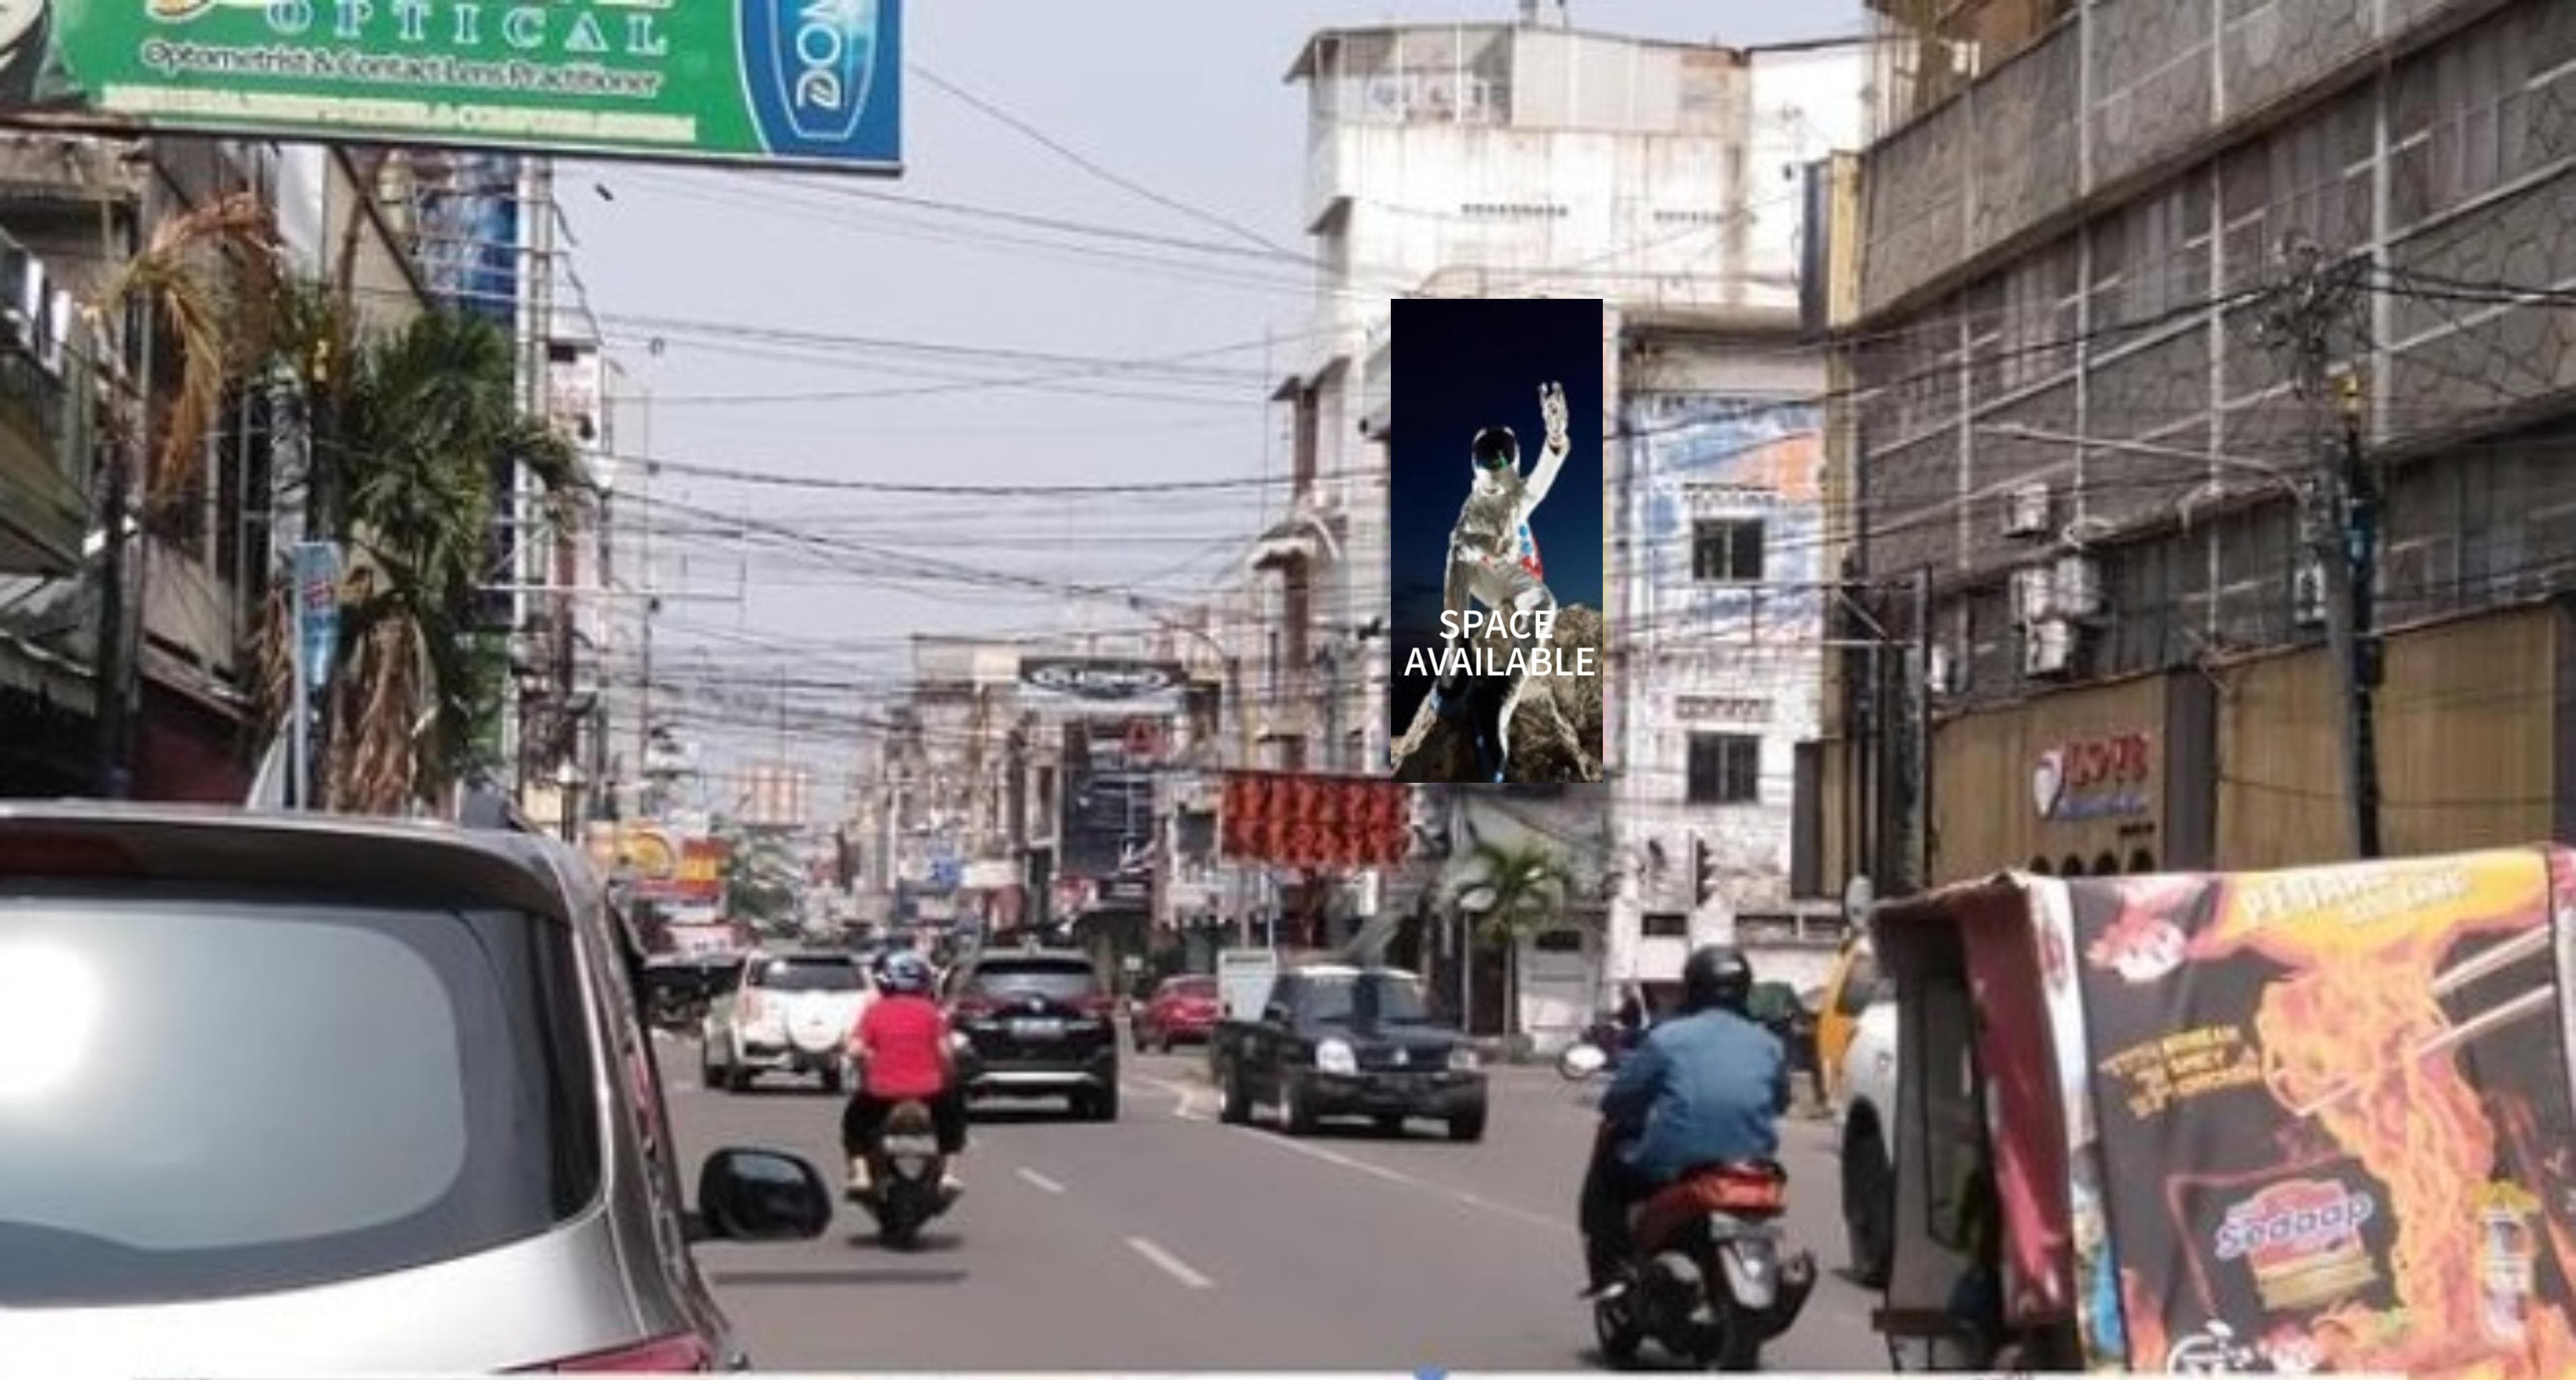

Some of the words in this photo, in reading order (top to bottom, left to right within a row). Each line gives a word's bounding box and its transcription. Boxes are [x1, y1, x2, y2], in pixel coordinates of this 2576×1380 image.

[265, 0, 668, 55] OPTICAL
[141, 39, 313, 77] Optometrist
[314, 47, 333, 77] &
[336, 48, 440, 83] Contact
[442, 54, 506, 88] Lens
[506, 59, 664, 98] Practitioner
[2214, 1191, 2375, 1260] Sedaap
